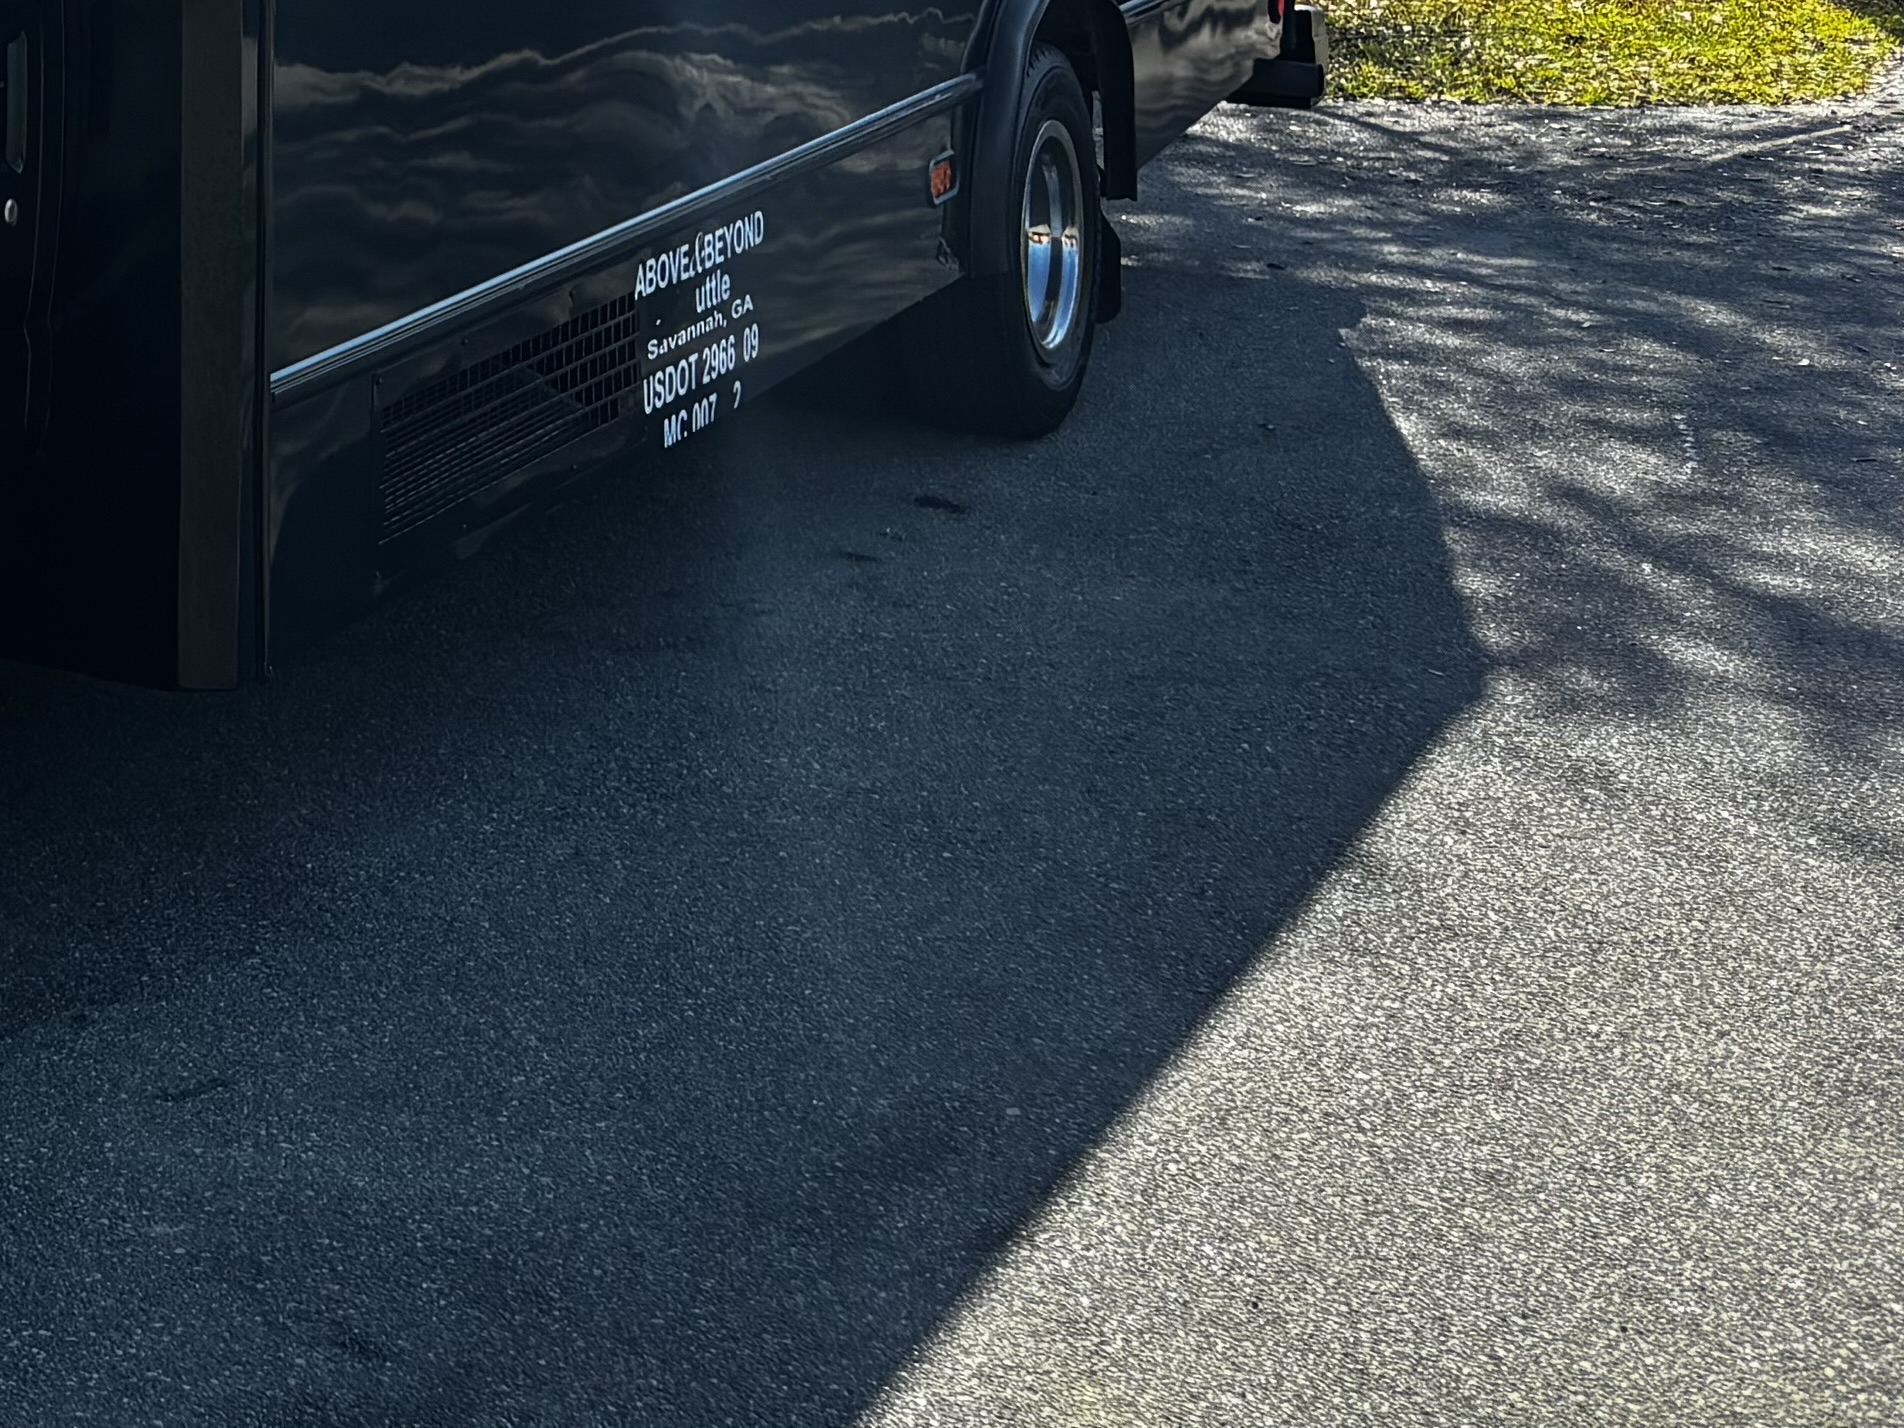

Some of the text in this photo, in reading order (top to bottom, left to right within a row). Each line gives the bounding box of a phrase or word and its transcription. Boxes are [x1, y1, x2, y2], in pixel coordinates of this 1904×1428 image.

[635, 243, 690, 301] ABOVE
[703, 210, 764, 269] BEYOND
[647, 294, 754, 360] Savannah, GA
[643, 352, 699, 414] USDOT
